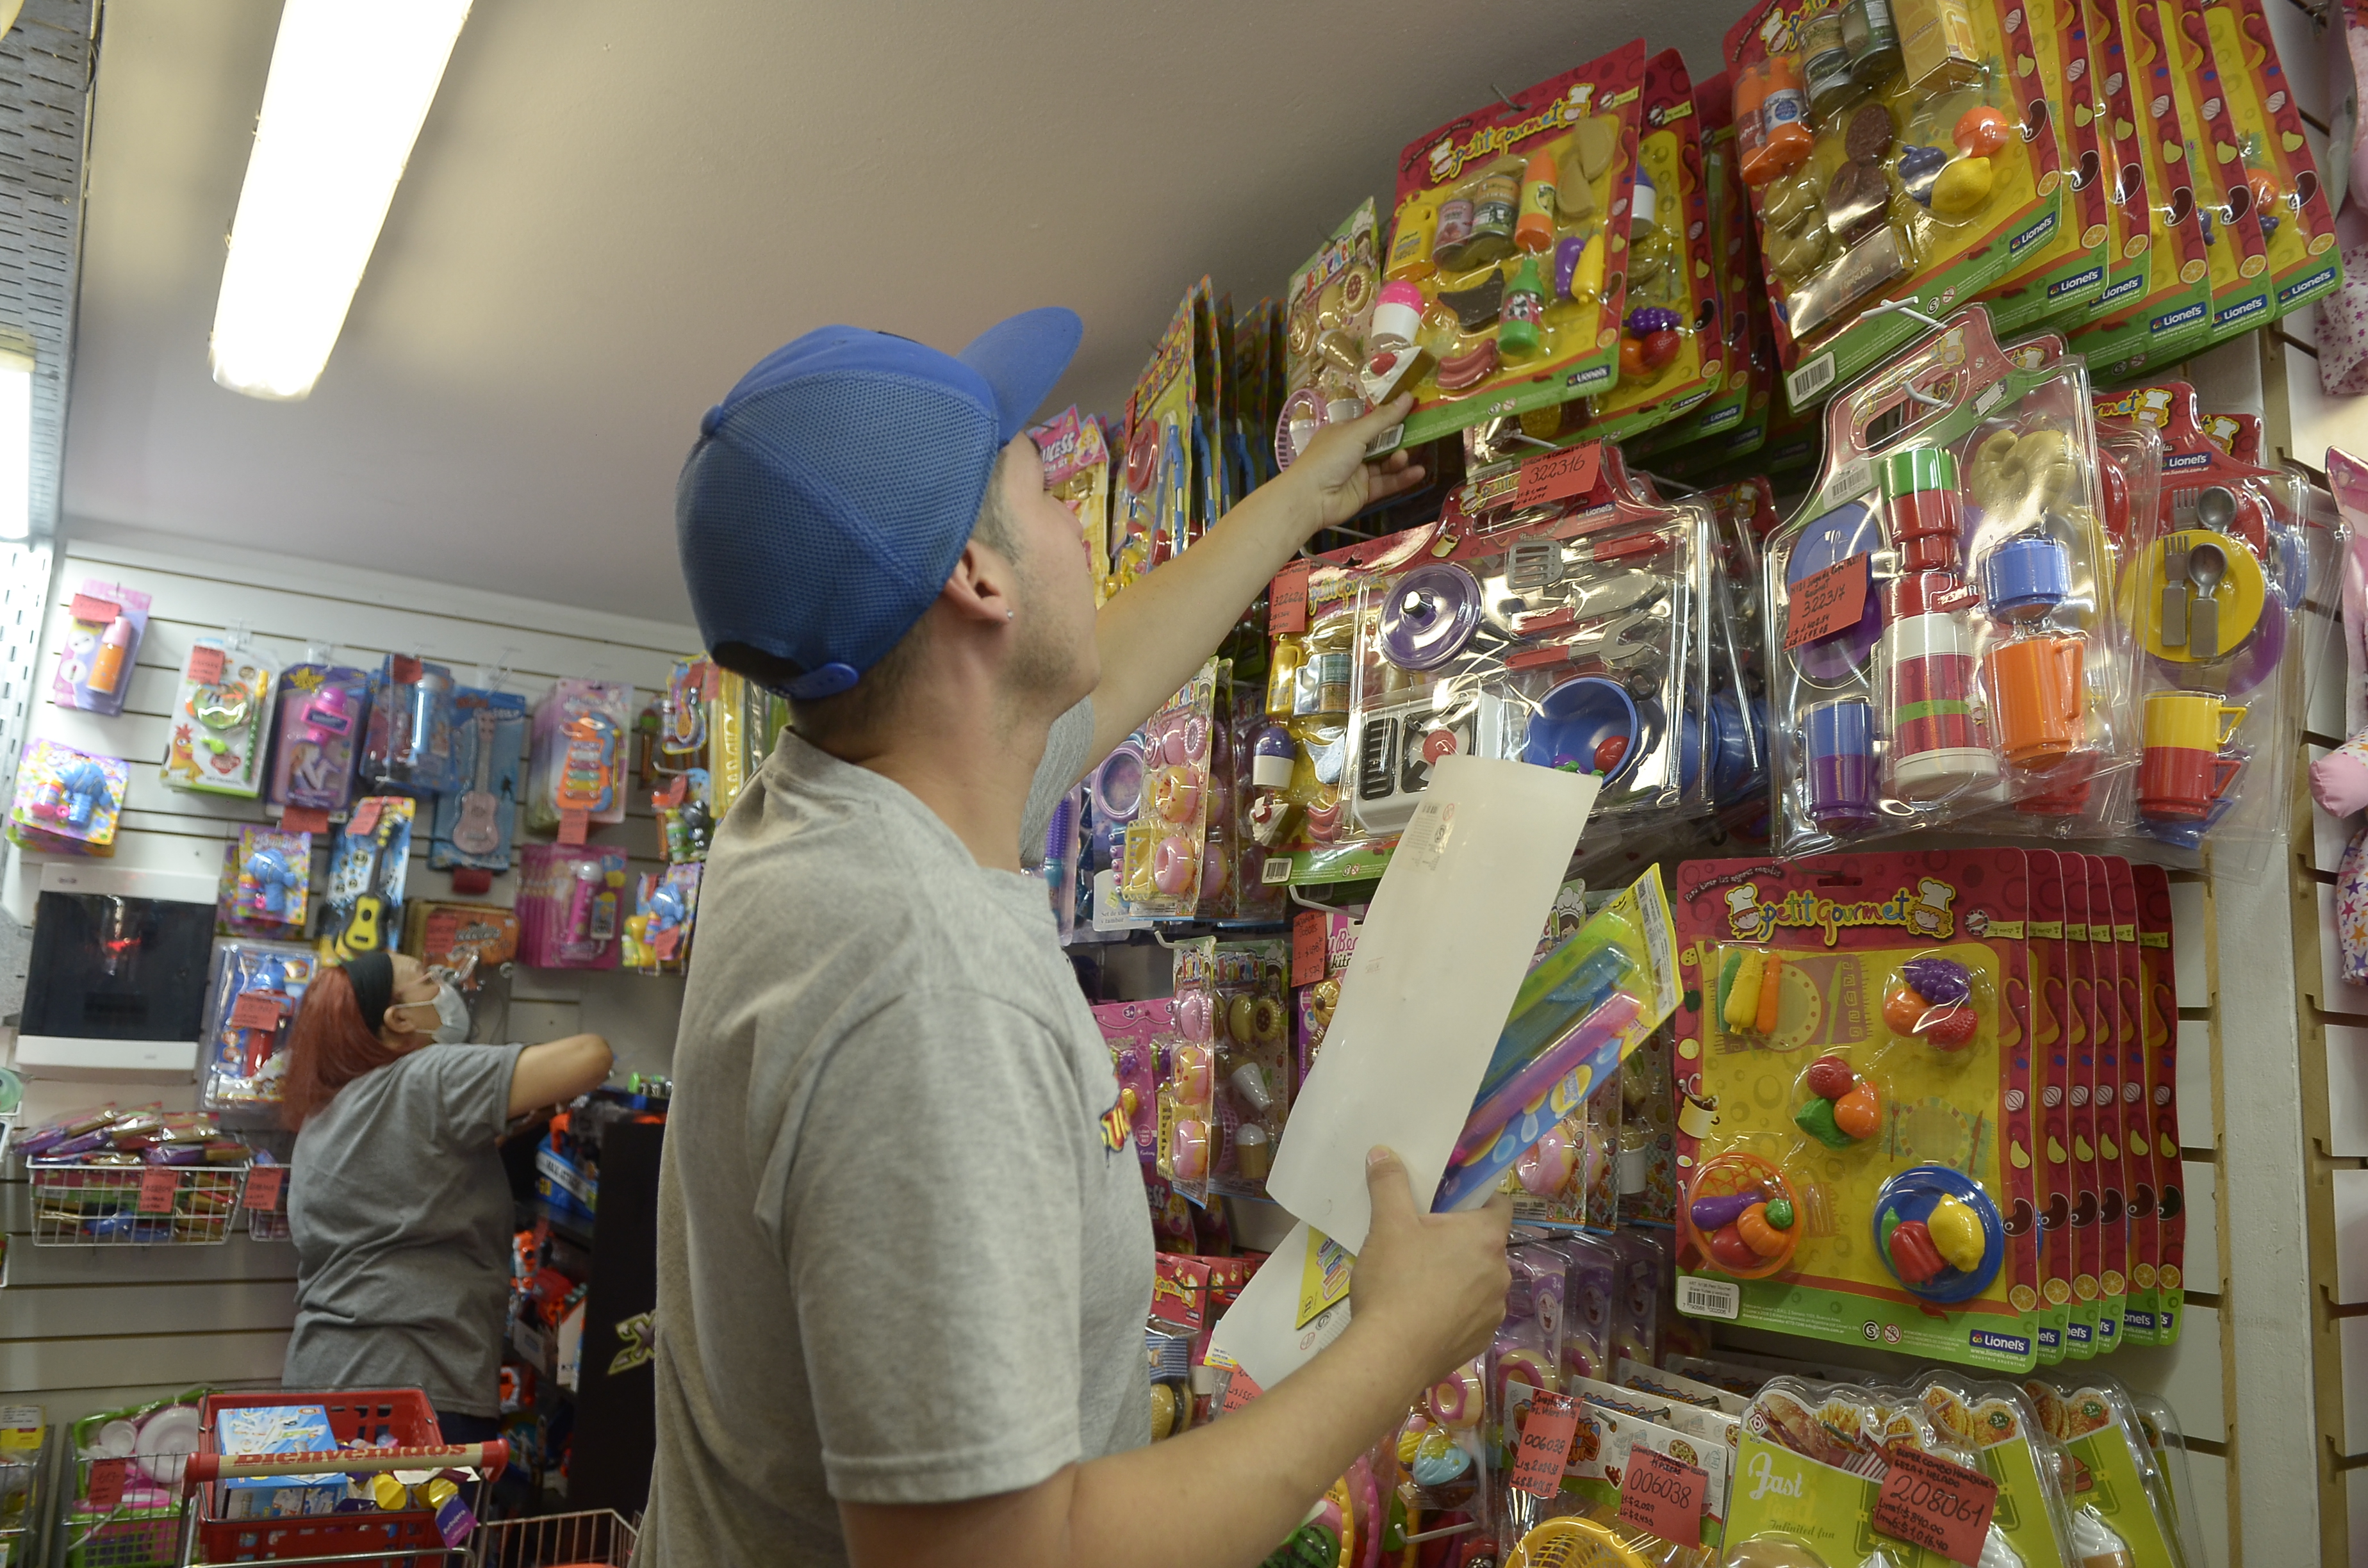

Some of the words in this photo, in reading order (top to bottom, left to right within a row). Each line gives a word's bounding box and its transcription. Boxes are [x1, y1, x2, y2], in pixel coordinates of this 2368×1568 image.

[1453, 129, 1492, 174] petit
[1494, 101, 1561, 154] gourmet
[2022, 216, 2052, 243] Lionel's
[2060, 270, 2099, 291] Lionel's
[2102, 278, 2139, 300] Lionel's
[2292, 271, 2331, 295] Lionel's
[2164, 304, 2202, 326] Lionel's
[2224, 298, 2263, 320] Lionel's
[1529, 453, 1585, 484] 322316
[2169, 454, 2207, 468] Lionel's
[1586, 503, 1613, 517] Lionel's
[1699, 878, 1717, 891] hacer
[1719, 874, 1729, 883] las
[1758, 893, 1816, 938] petit
[1817, 890, 1909, 942] gourmet
[1984, 1335, 2026, 1352] Lionel's
[1970, 1348, 2027, 1363] www.lionels.com.ar
[1998, 1359, 2026, 1368] ARGENTINA
[1994, 1416, 2003, 1424] 3+
[2086, 1405, 2096, 1413] 3+
[1524, 1433, 1566, 1455] 006038
[1748, 1451, 1802, 1499] Fast
[1927, 1470, 1960, 1488] HELADO
[1630, 1467, 1691, 1509] 006038
[1891, 1475, 1985, 1527] 208061
[1818, 1528, 1834, 1539] fun
